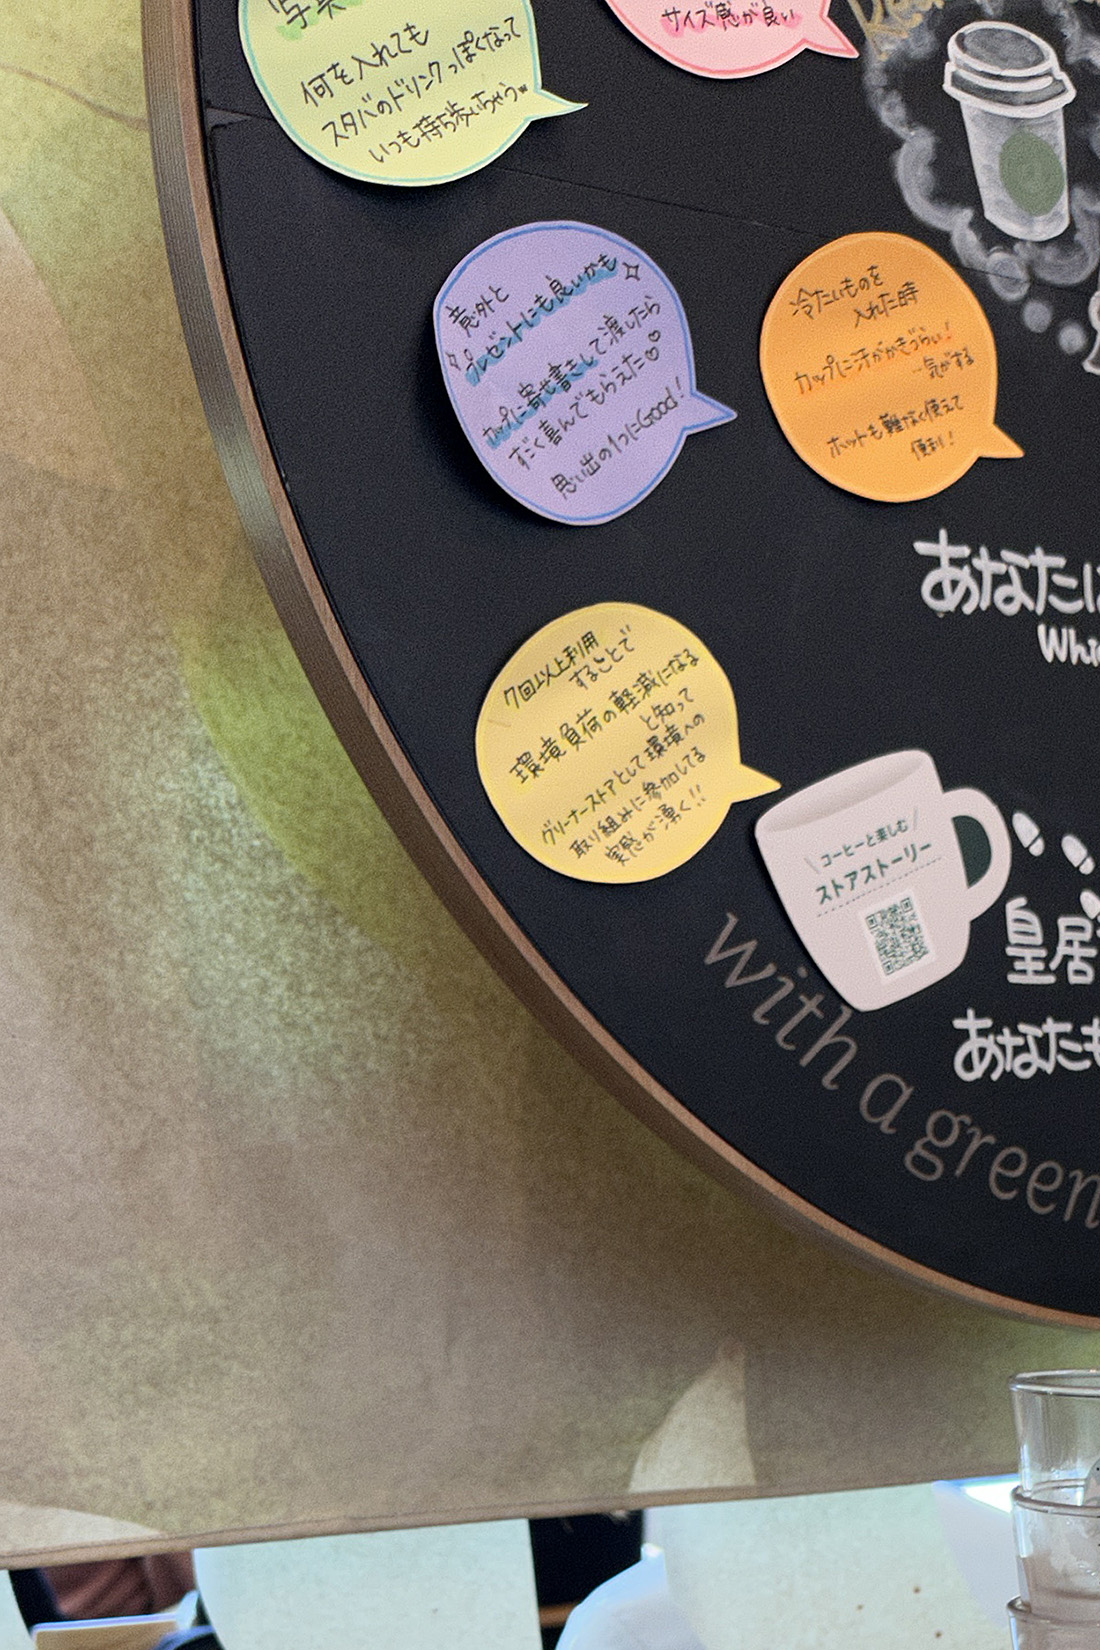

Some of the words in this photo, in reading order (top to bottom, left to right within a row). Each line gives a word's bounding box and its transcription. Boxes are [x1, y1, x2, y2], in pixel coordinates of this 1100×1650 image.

[301, 23, 430, 108] 何を入れても
[321, 17, 522, 147] スタバのドリンクっぽくなって
[789, 264, 884, 320] 冷たいものを
[854, 281, 919, 328] 入れた時
[568, 624, 635, 690] することで
[508, 648, 701, 785] 環境負荷の軽減になる
[639, 686, 696, 731] と知って
[815, 841, 933, 906] ストアストーリー
[820, 817, 910, 869] コーヒーと楽しむ
[703, 910, 861, 1092] with
[857, 1068, 916, 1135] a
